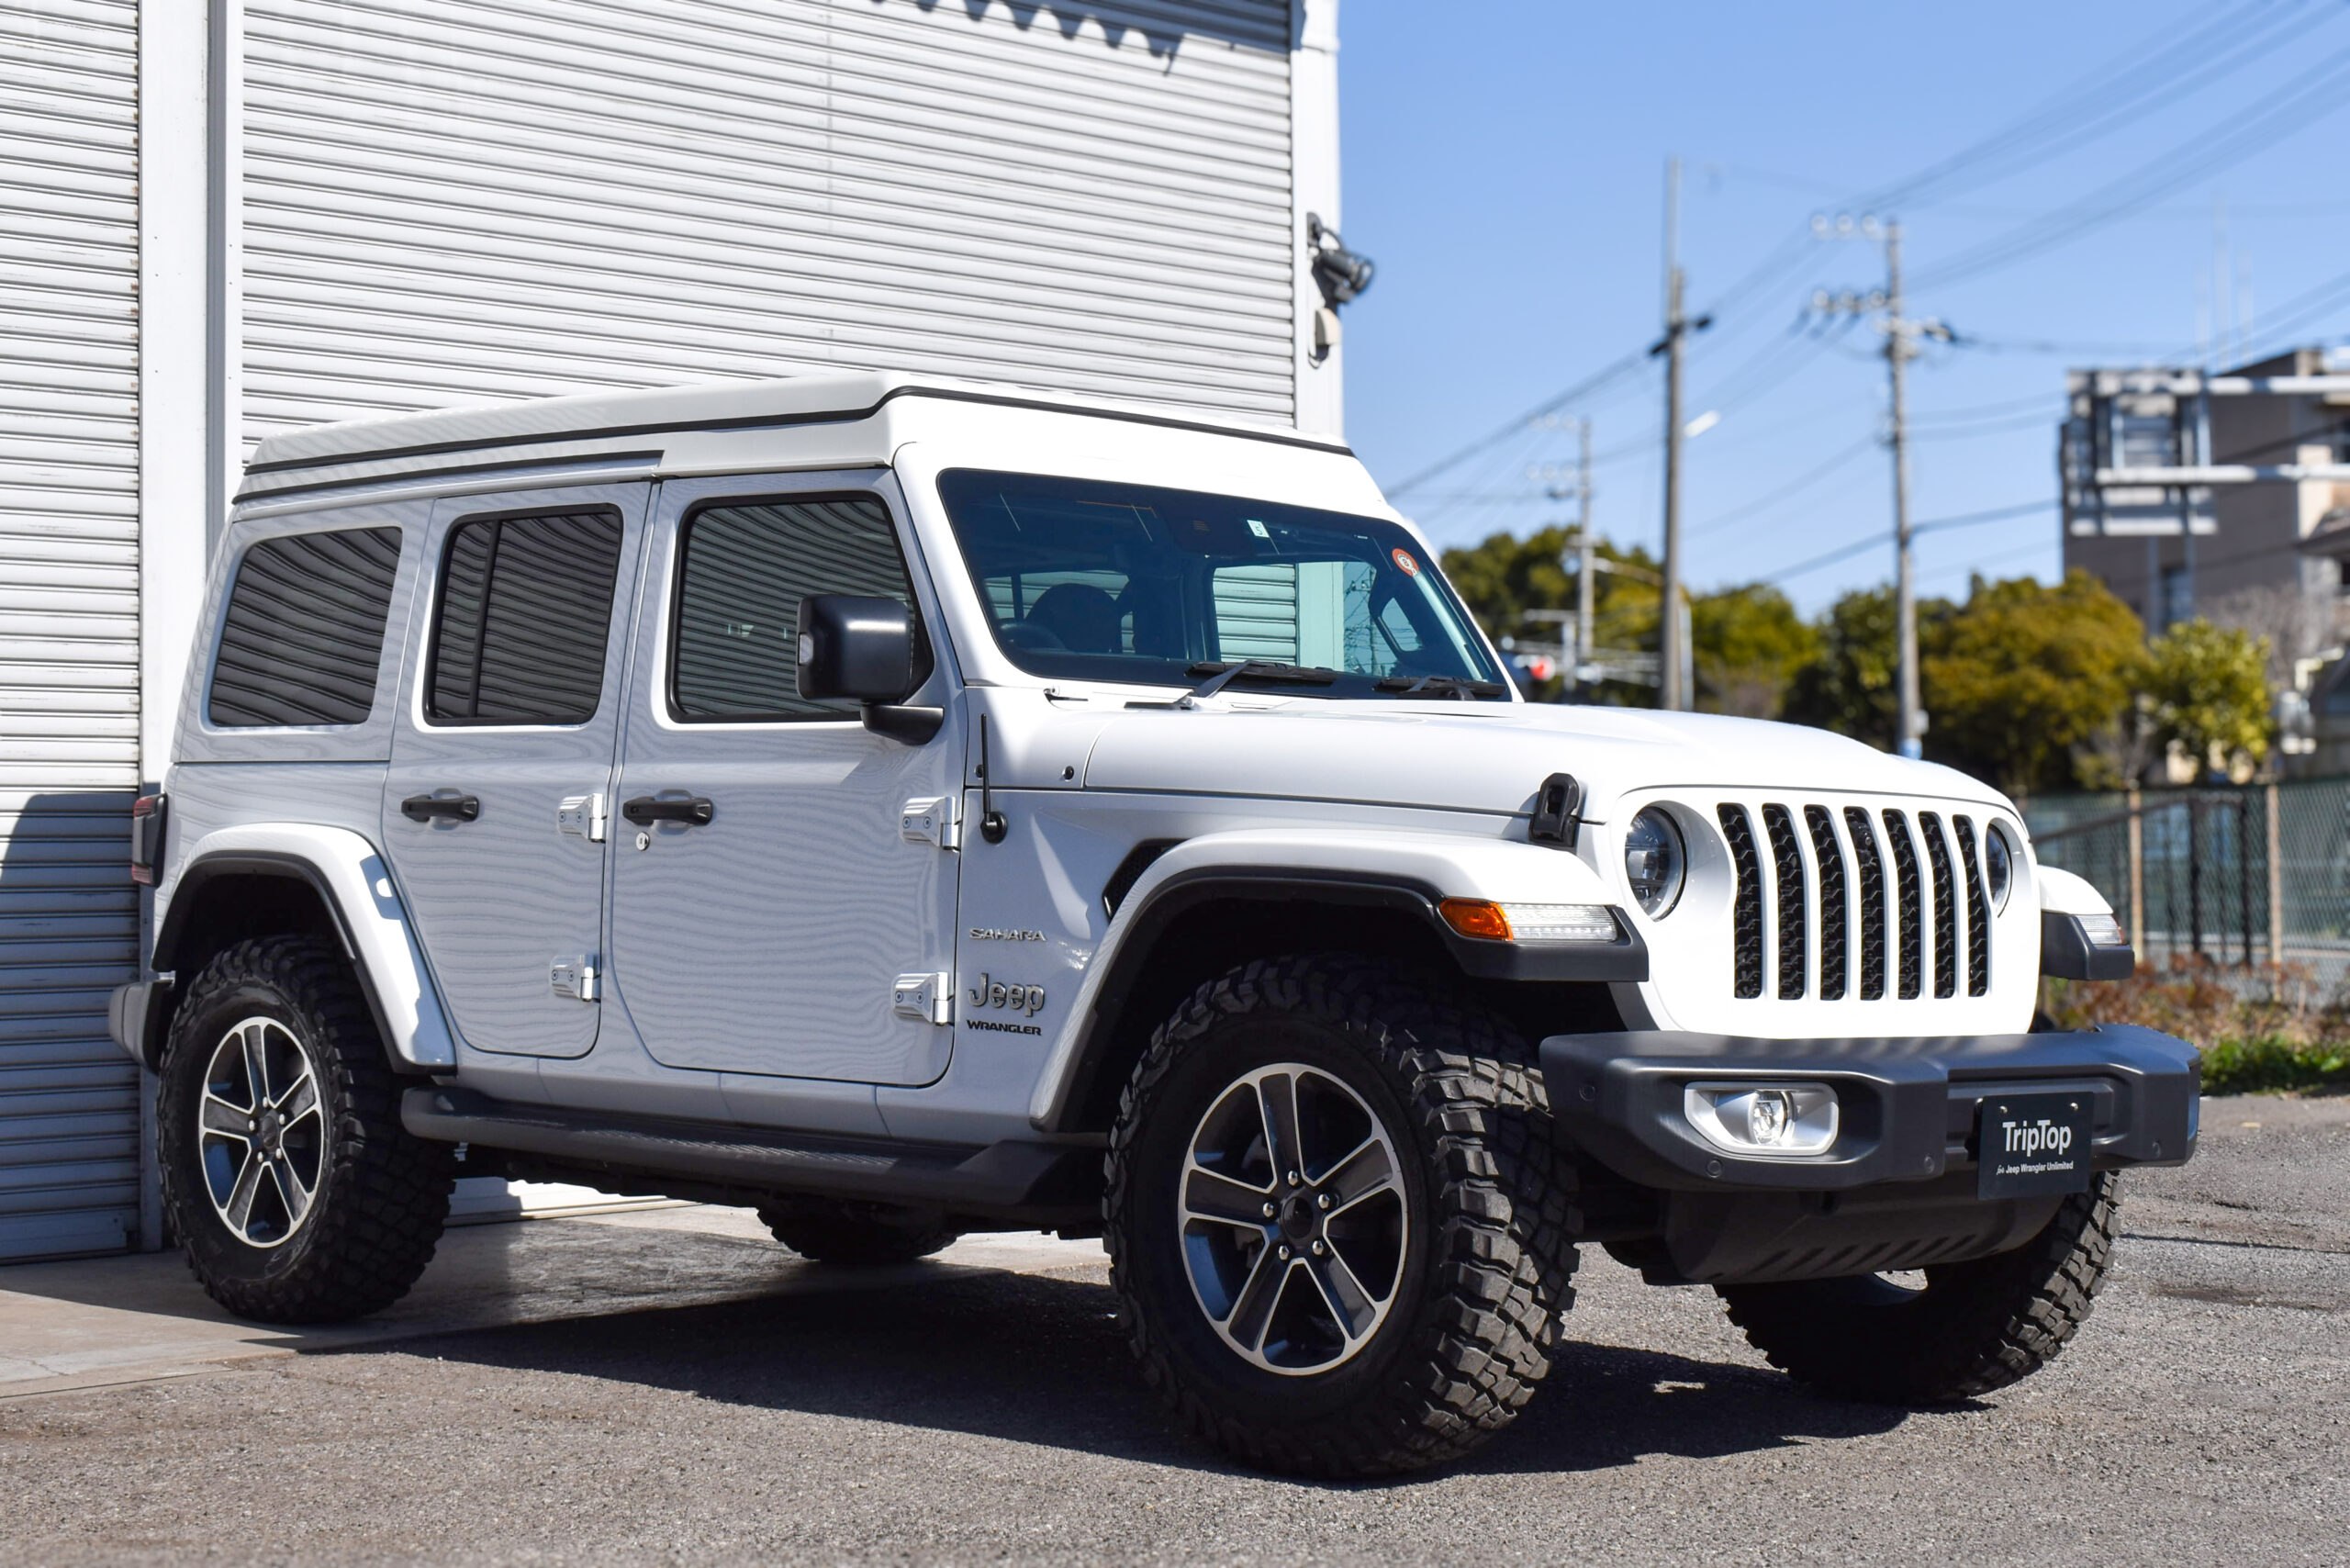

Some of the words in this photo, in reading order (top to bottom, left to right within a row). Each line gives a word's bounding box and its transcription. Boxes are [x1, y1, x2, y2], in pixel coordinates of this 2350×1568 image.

[968, 927, 1046, 942] SAHARA
[968, 972, 1045, 1018] Jeep
[967, 1019, 1042, 1036] WRANGLER
[2002, 1119, 2072, 1157] TripTop
[2006, 1165, 2020, 1175] Jeep
[2020, 1163, 2046, 1173] Wrangler
[2047, 1160, 2074, 1170] Unlimited
